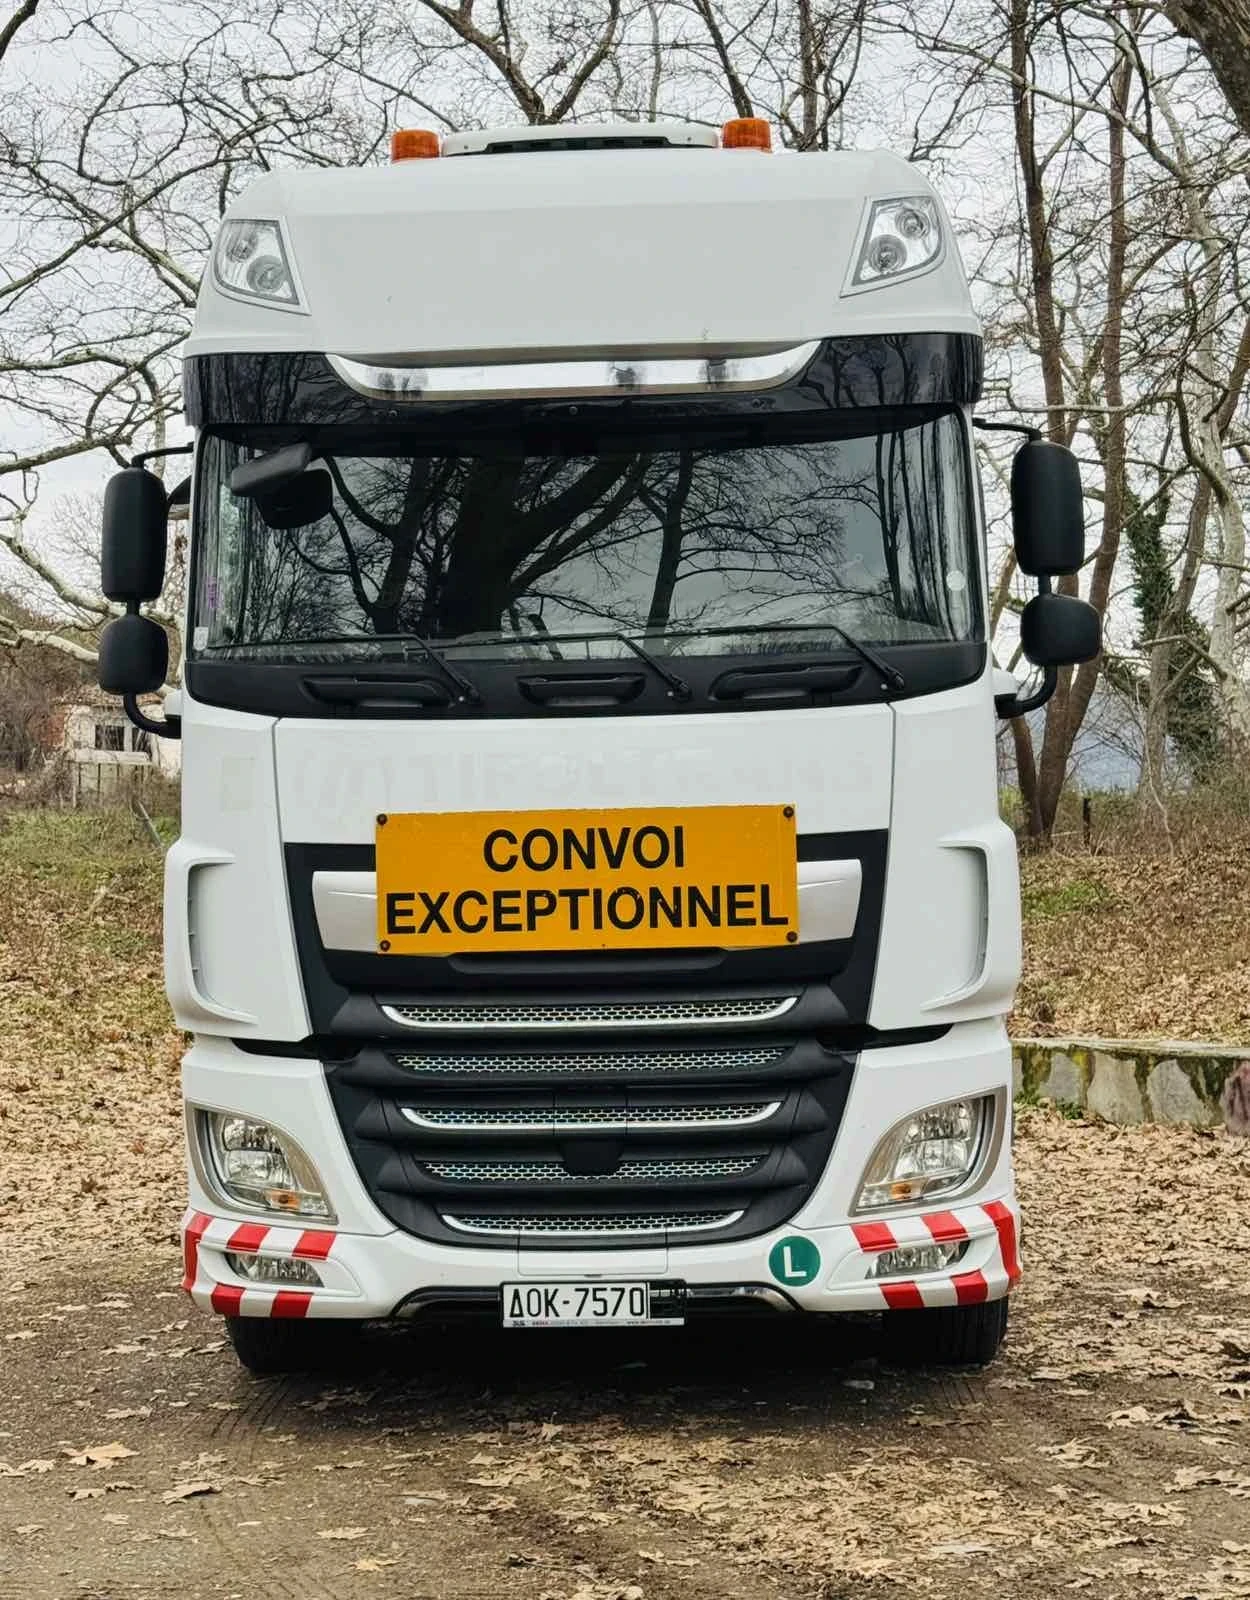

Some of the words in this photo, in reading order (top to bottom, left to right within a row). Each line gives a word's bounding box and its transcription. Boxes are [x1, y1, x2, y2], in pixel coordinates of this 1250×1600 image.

[482, 825, 684, 873] CONVOI
[386, 884, 790, 935] EXCEPTIONNEL
[783, 1246, 807, 1277] L
